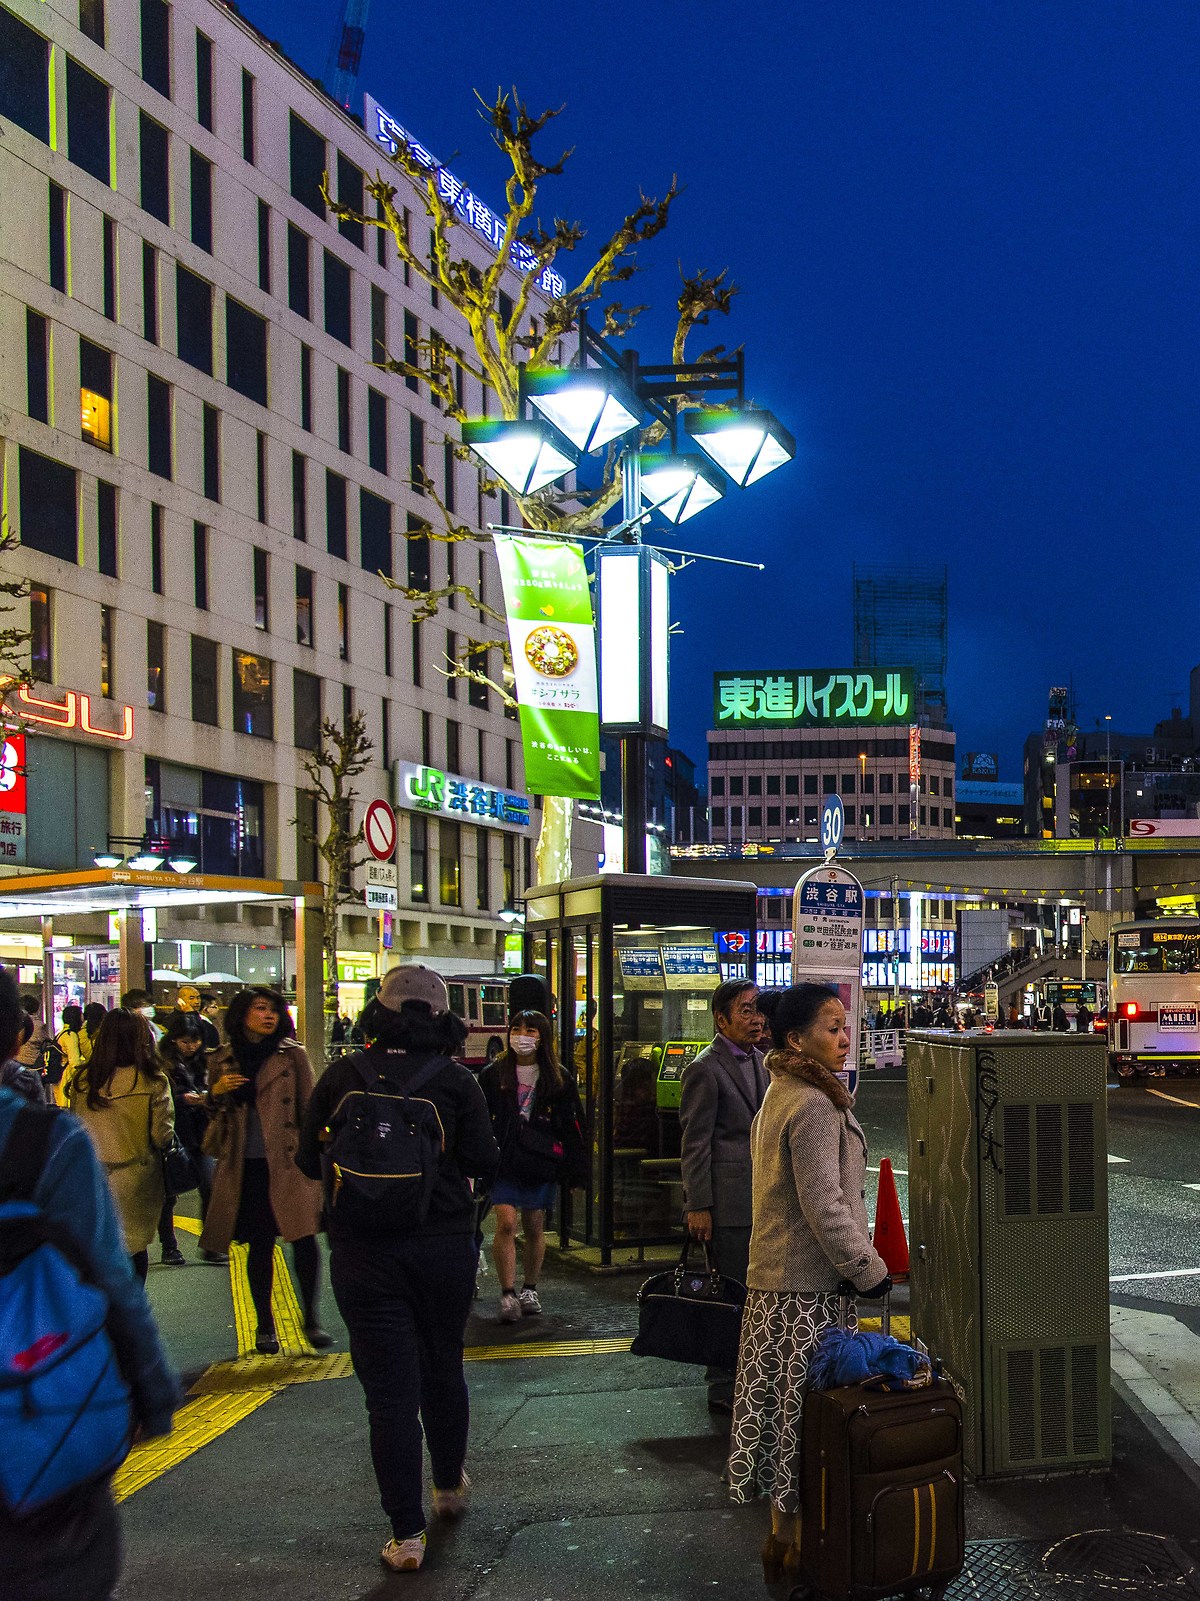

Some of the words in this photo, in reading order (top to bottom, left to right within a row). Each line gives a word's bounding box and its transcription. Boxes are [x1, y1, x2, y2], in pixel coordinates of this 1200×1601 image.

[719, 673, 909, 720] 東進ハイスクール
[410, 768, 446, 803] JR
[448, 781, 505, 820] 渋谷駅
[823, 807, 841, 846] 30
[806, 886, 858, 903] 渋谷駅
[1161, 1013, 1195, 1022] MIBU
